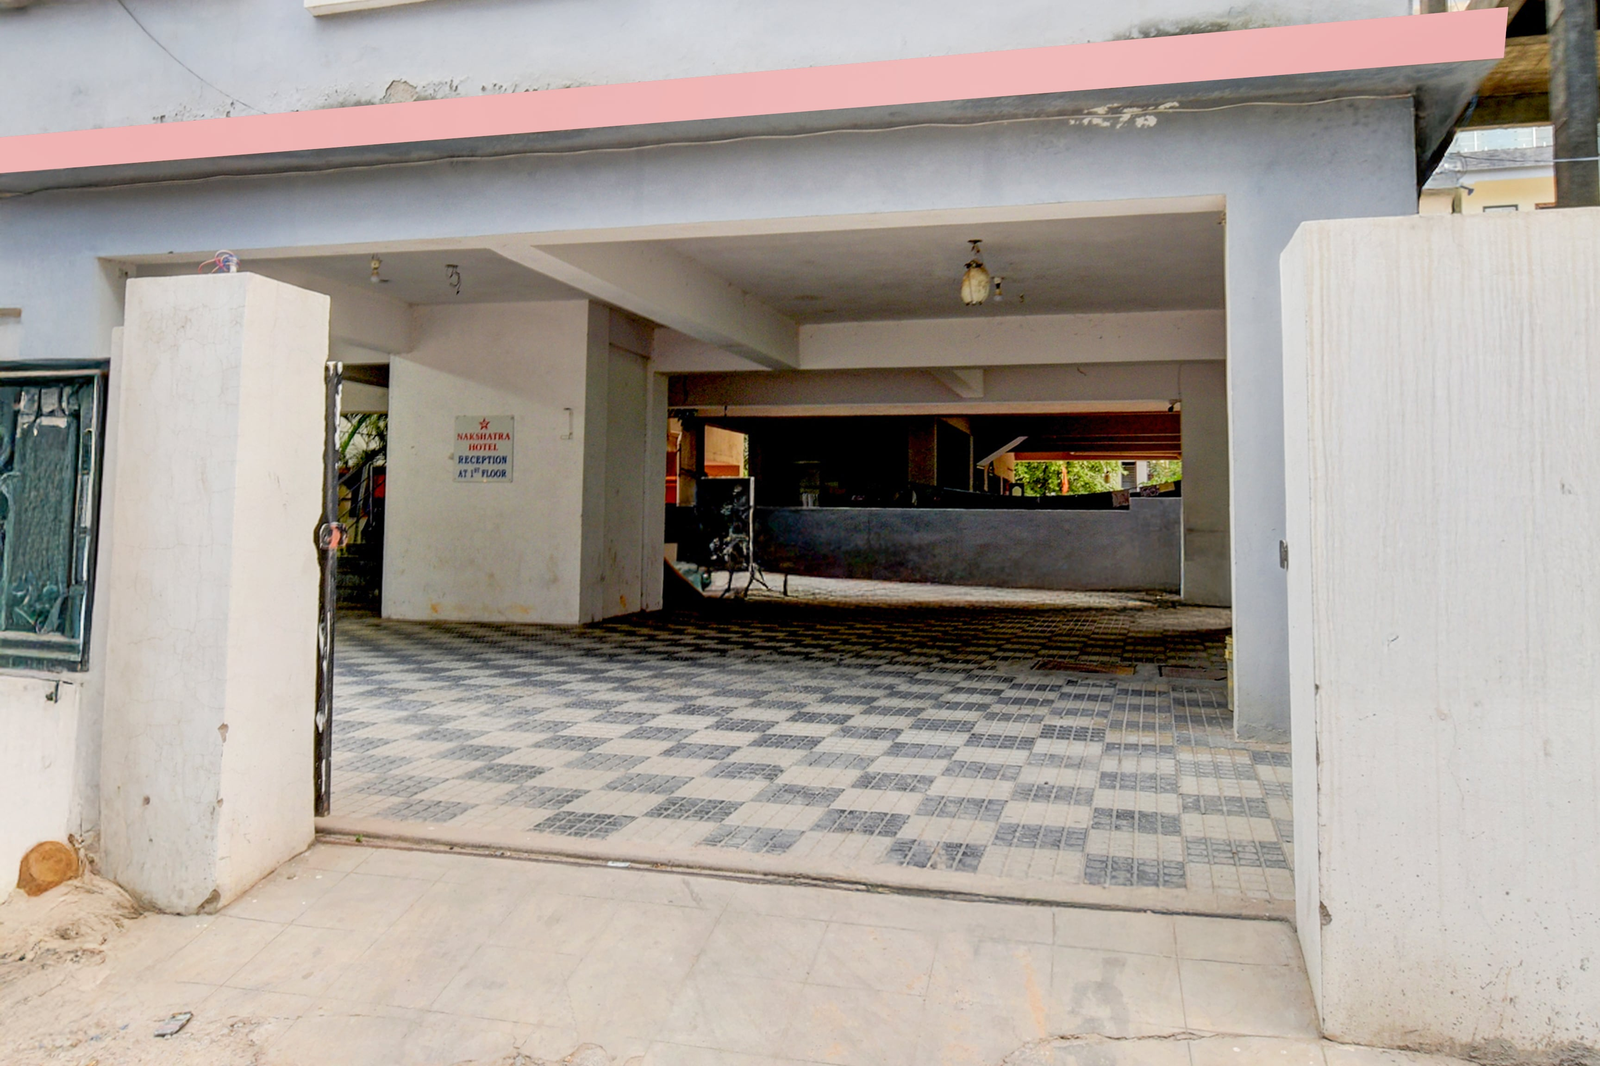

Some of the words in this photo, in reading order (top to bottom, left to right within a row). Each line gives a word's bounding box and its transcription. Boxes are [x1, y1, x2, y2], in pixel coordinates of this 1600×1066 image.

[457, 432, 510, 440] NAKSHATRA
[468, 443, 498, 451] HOTEL
[458, 455, 508, 464] RECEPTION
[458, 469, 468, 478] AT
[481, 469, 507, 478] FLOOR
